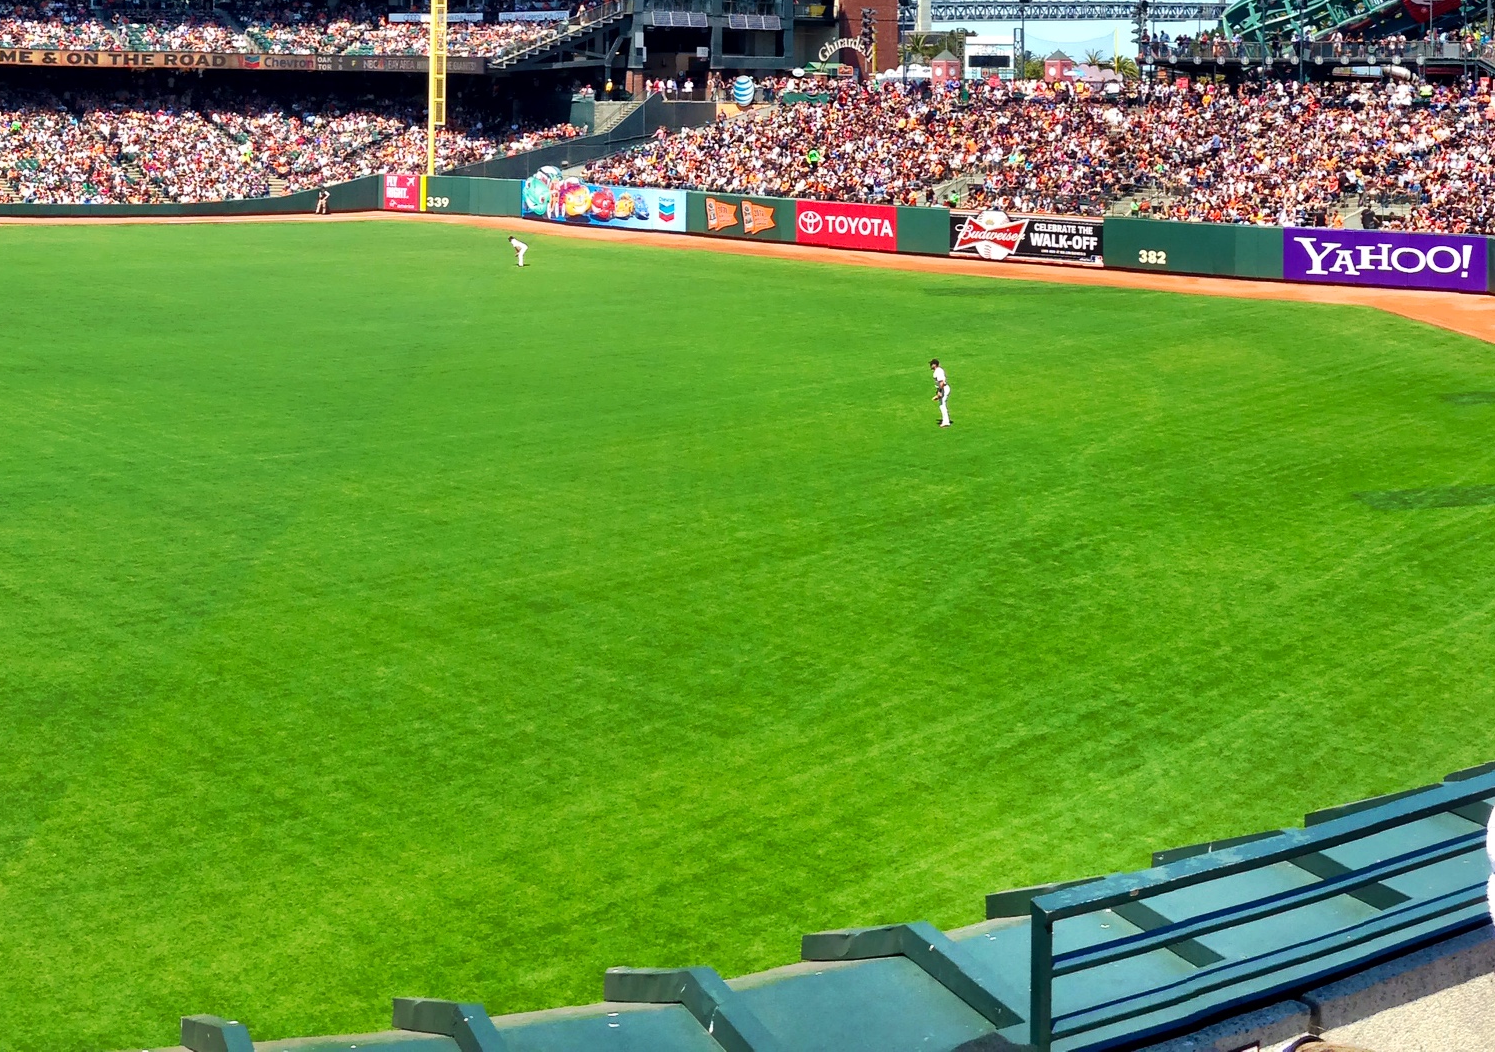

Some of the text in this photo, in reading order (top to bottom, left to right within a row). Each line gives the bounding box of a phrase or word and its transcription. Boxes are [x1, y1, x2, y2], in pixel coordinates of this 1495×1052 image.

[42, 52, 58, 64] &
[67, 53, 99, 65] ON
[108, 54, 154, 66] THE
[164, 55, 227, 67] ROAD
[264, 57, 314, 69] Chevron
[426, 196, 449, 208] 339
[824, 214, 894, 238] TOYOTA
[955, 223, 1026, 241] Budweiser
[1034, 222, 1093, 235] CELEBRATE THE
[1029, 232, 1098, 250] WALK-OFF
[1138, 249, 1167, 265] 382
[1293, 236, 1473, 278] YAHOO!
